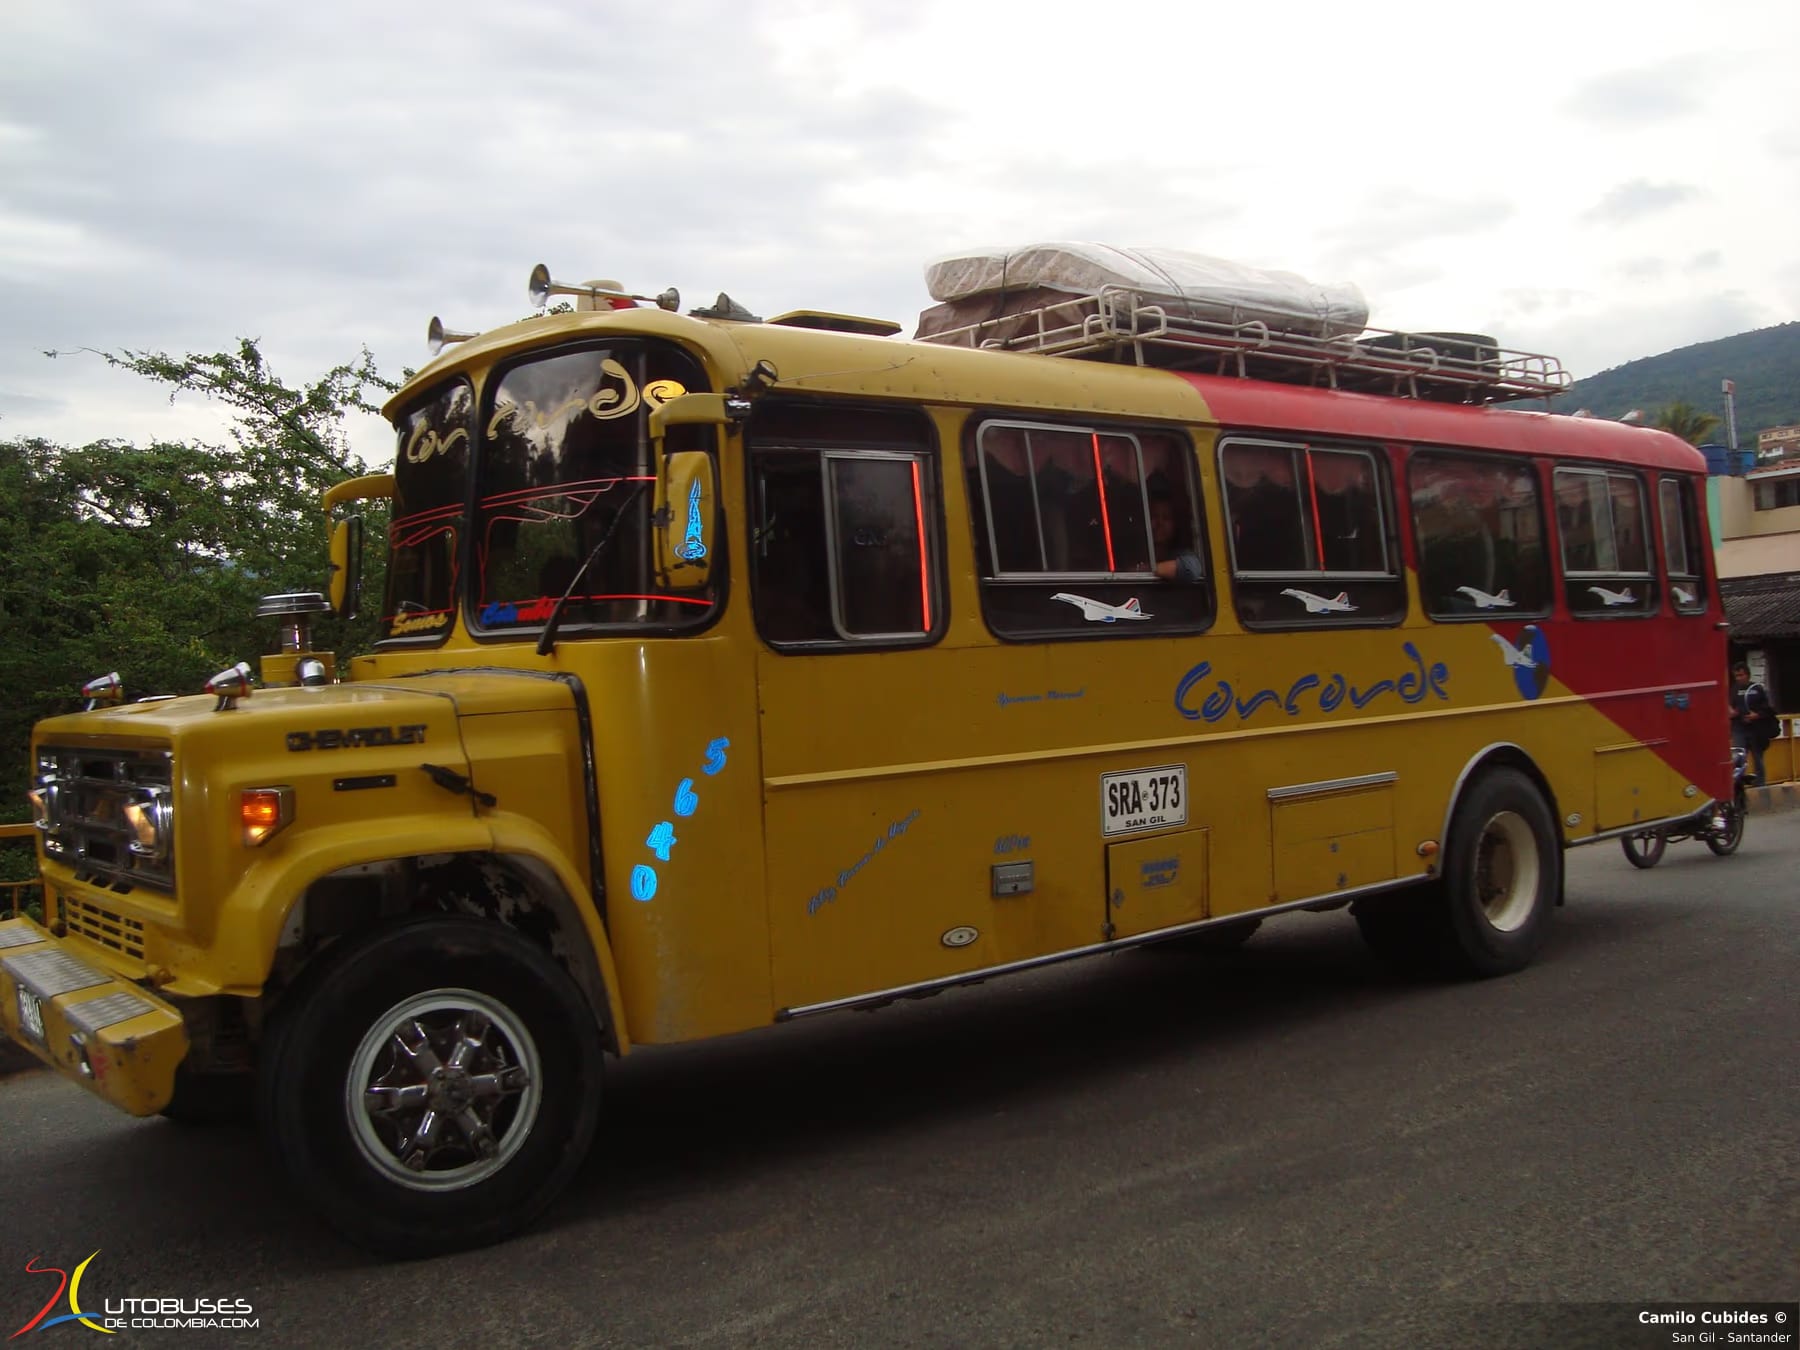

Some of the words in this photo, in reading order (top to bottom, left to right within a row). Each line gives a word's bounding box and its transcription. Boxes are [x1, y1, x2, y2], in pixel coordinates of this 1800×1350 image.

[1173, 641, 1450, 723] Concorde
[286, 723, 428, 752] CHEVROLET
[1108, 780, 1143, 818] SRA
[1148, 774, 1181, 812] 373
[1125, 818, 1147, 828] SAN
[1149, 815, 1167, 824] GIL
